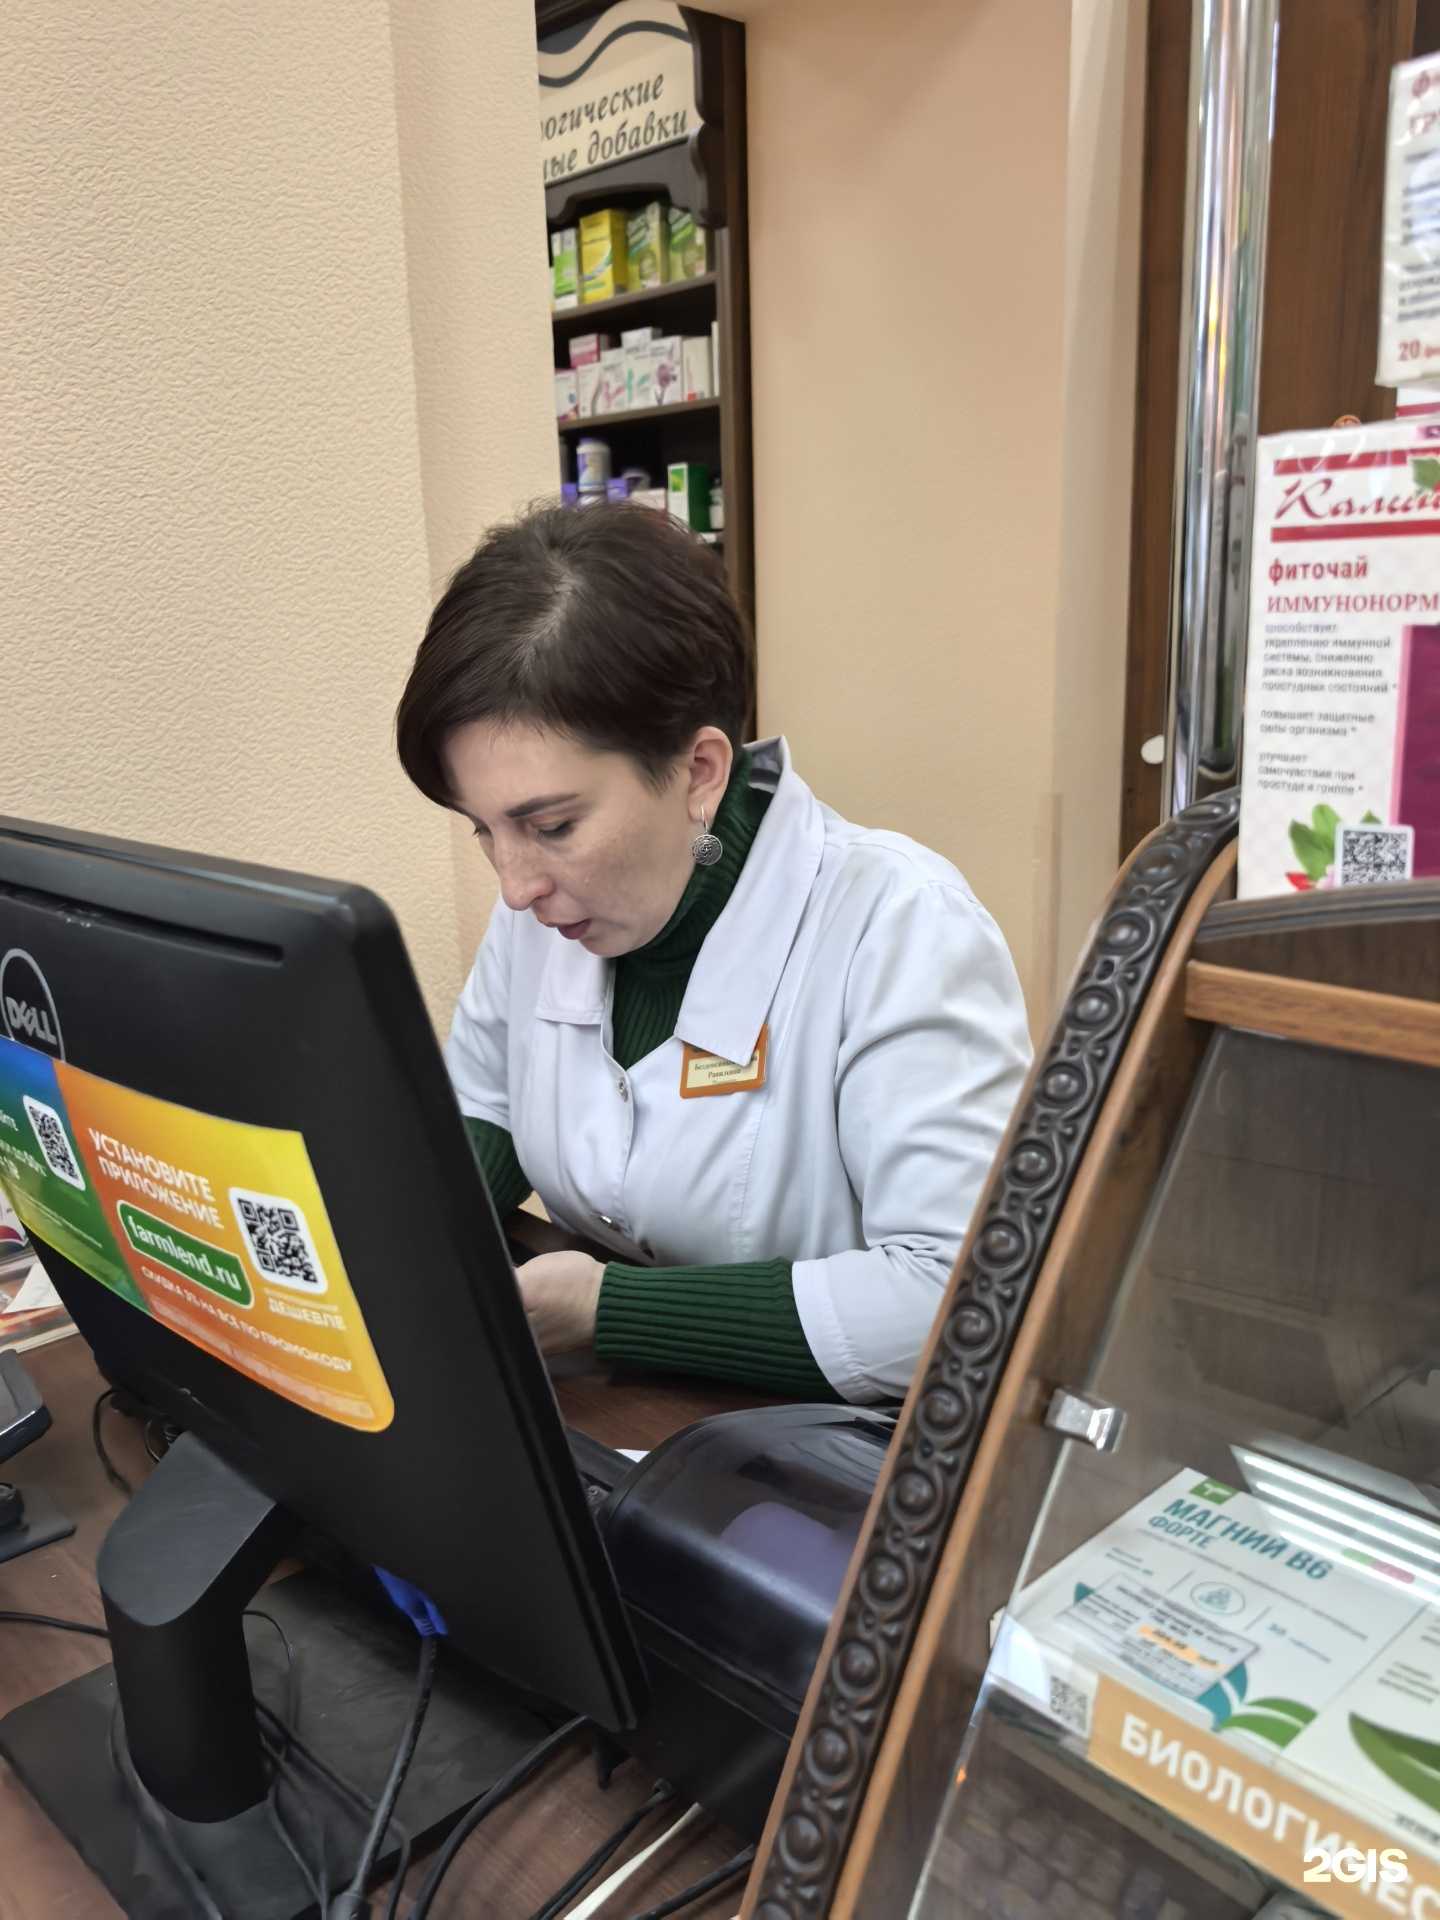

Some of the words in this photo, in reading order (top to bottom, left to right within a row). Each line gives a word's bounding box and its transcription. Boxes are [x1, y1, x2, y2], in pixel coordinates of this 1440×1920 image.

[588, 110, 688, 165] добавки
[1268, 556, 1367, 586] фиточай
[1266, 593, 1439, 613] ИММУНОНОРМ
[6, 996, 57, 1046] DELL
[88, 1127, 216, 1203] УСТАНОВИТЕ
[98, 1156, 225, 1230] ПРИЛОЖЕНИЕ
[128, 1215, 242, 1291] farmlend.ru
[1149, 1515, 1213, 1550] ФОРТЕ
